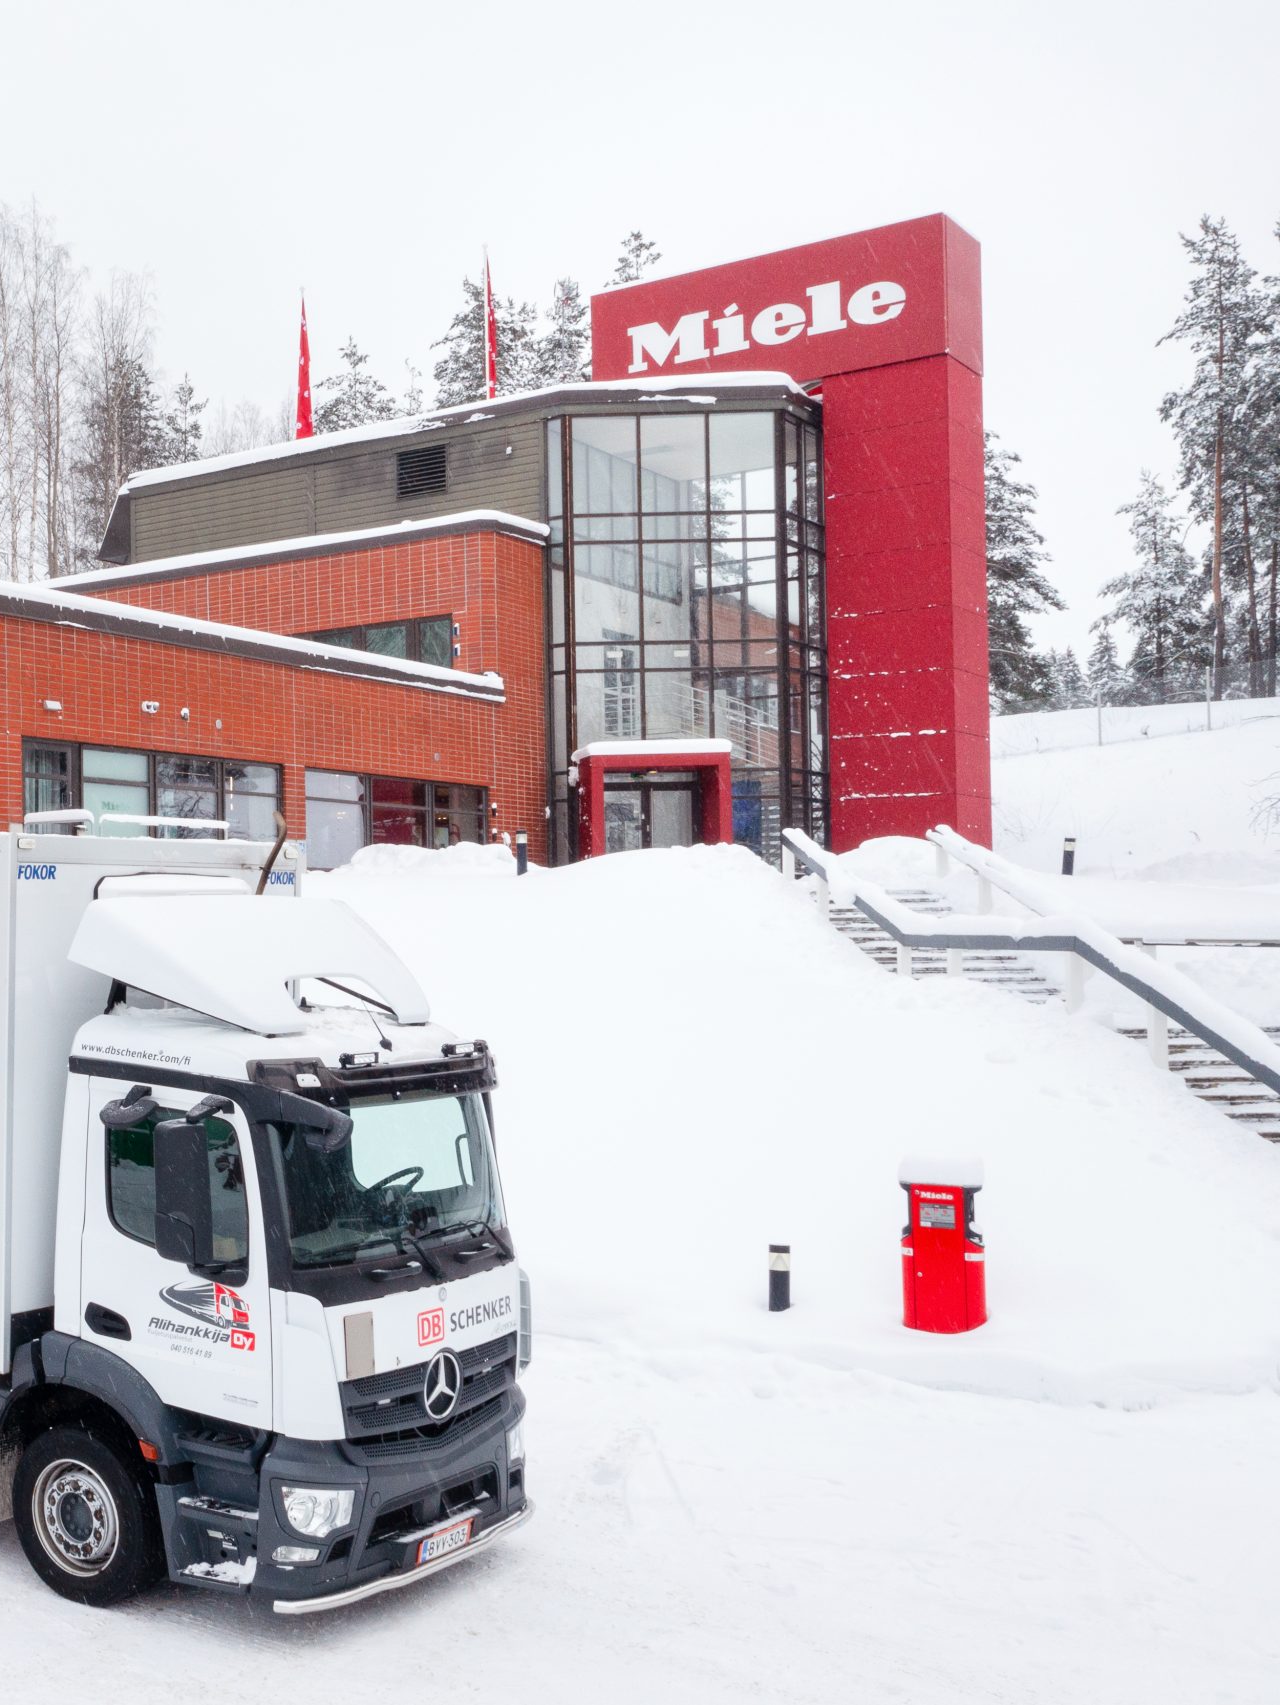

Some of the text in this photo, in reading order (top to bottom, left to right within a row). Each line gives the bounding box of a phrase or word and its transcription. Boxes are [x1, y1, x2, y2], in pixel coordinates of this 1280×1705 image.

[627, 280, 907, 375] Miele
[17, 864, 56, 881] FOKOR
[267, 871, 295, 885] OKOR
[81, 1043, 192, 1066] www.dbschenker.com/fi
[148, 1317, 230, 1343] Alihankkija
[420, 1312, 442, 1341] DB
[449, 1295, 512, 1332] SCHENKER
